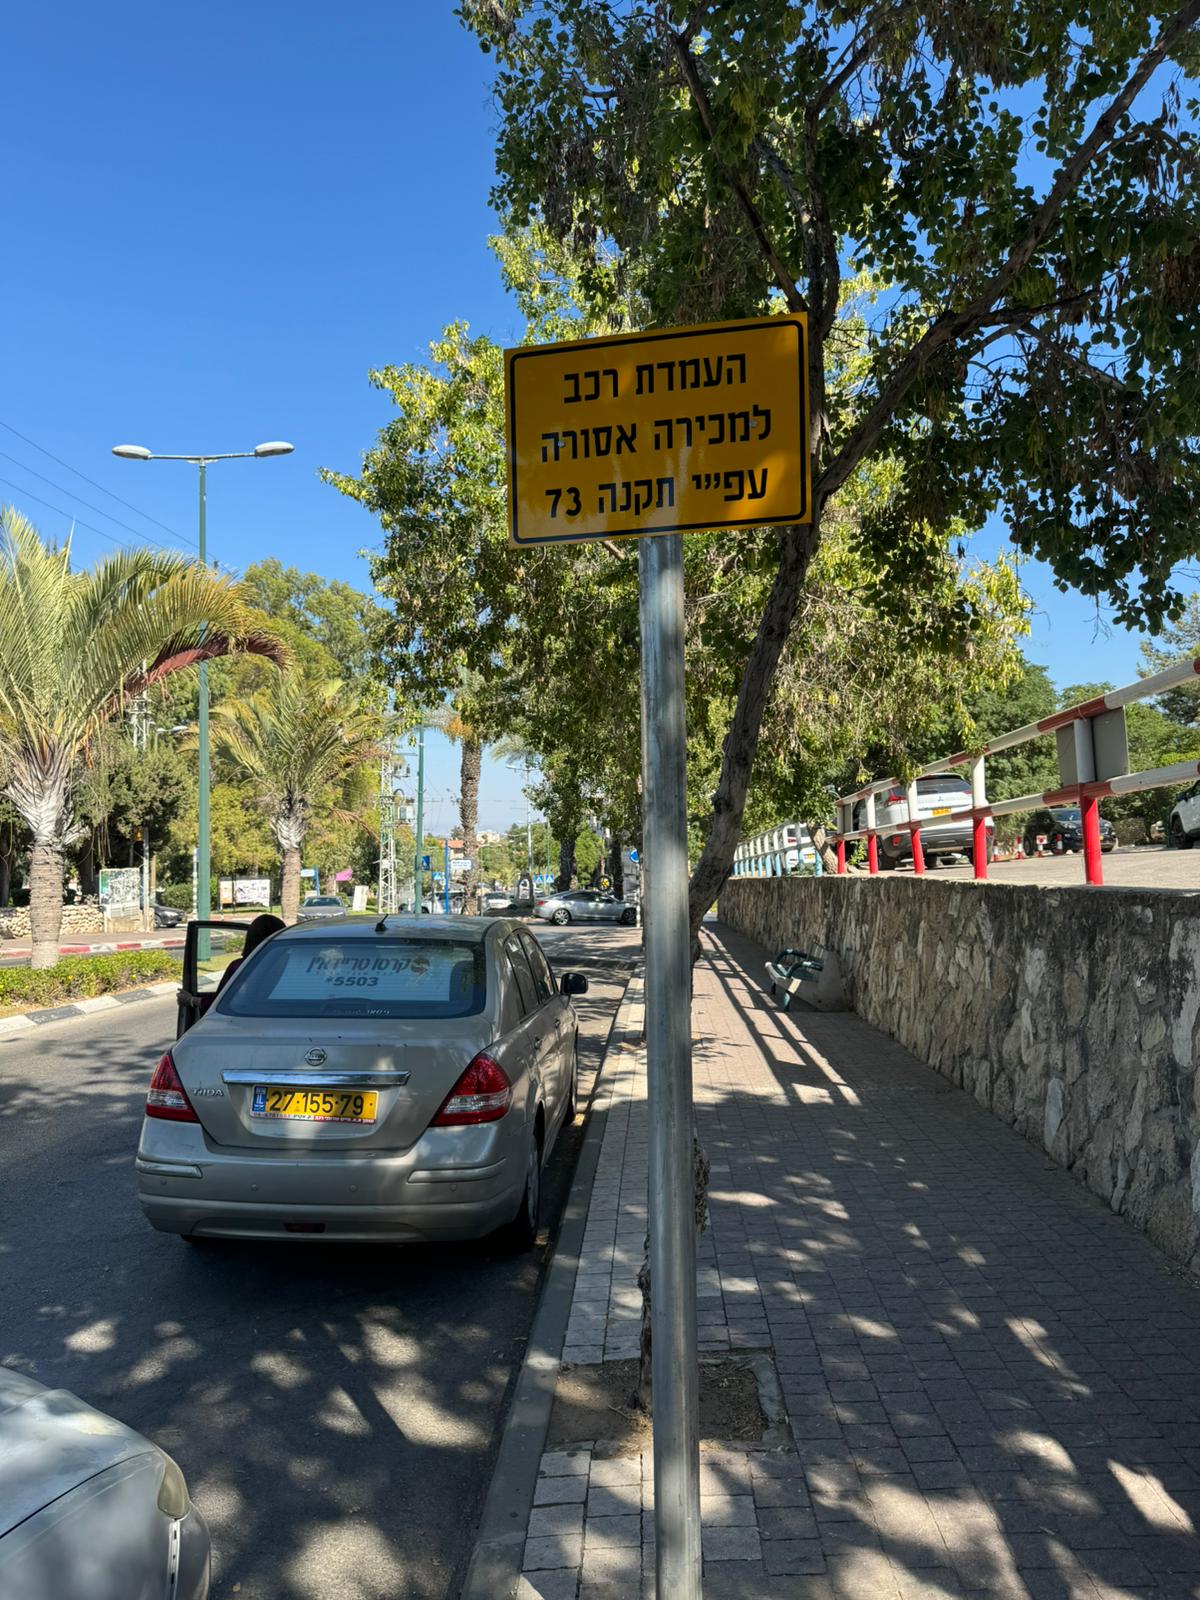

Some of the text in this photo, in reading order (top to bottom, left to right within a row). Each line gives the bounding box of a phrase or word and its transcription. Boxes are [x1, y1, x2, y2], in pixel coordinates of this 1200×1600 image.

[563, 353, 746, 404] העמדת רכב
[541, 404, 771, 463] למכירה אסורה
[545, 486, 582, 518] 73
[598, 477, 674, 516] תקנה
